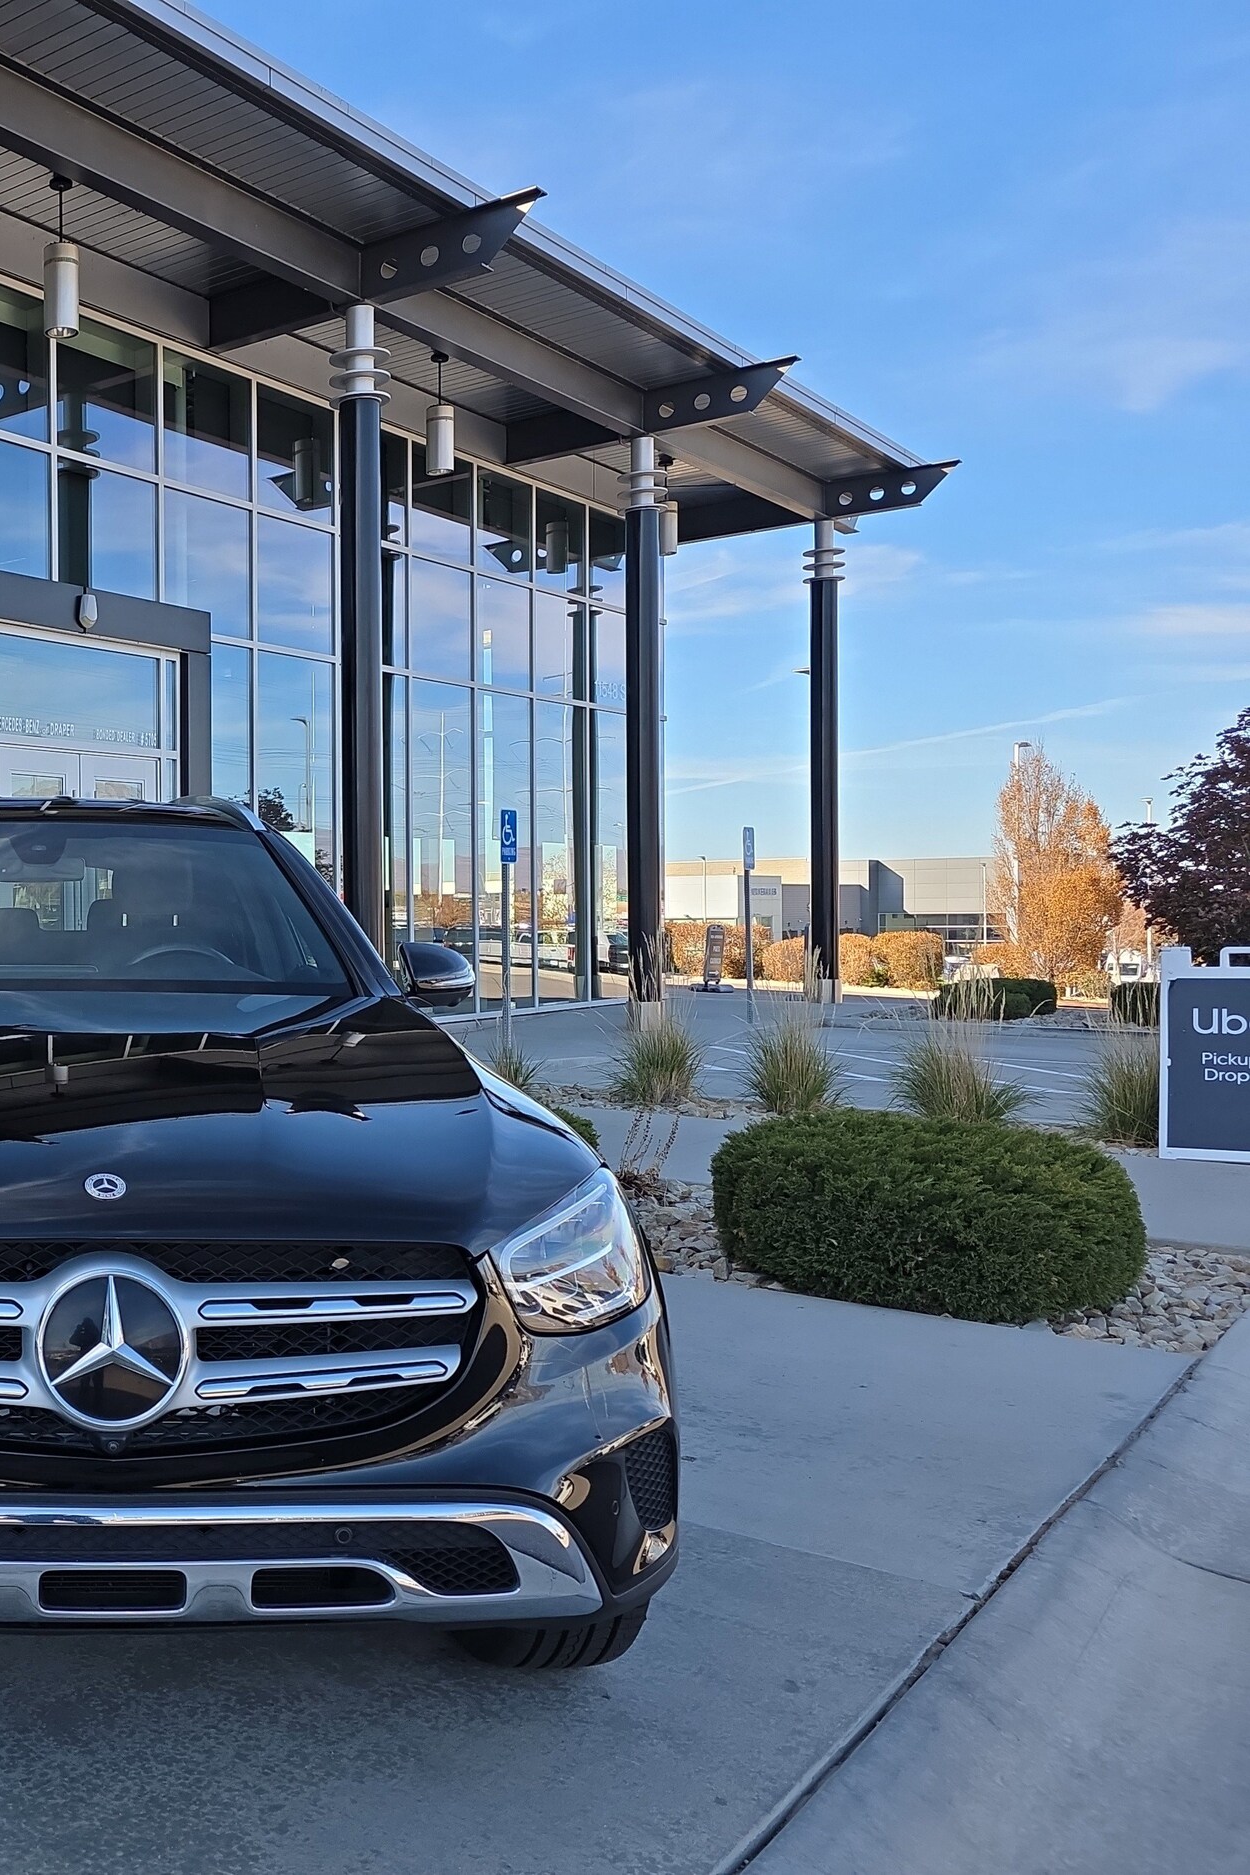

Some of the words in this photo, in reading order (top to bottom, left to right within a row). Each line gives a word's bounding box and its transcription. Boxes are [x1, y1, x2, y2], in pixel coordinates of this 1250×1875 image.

[50, 722, 75, 737] DRAPER
[1192, 1007, 1250, 1035] Ub
[1201, 1052, 1250, 1069] Picku
